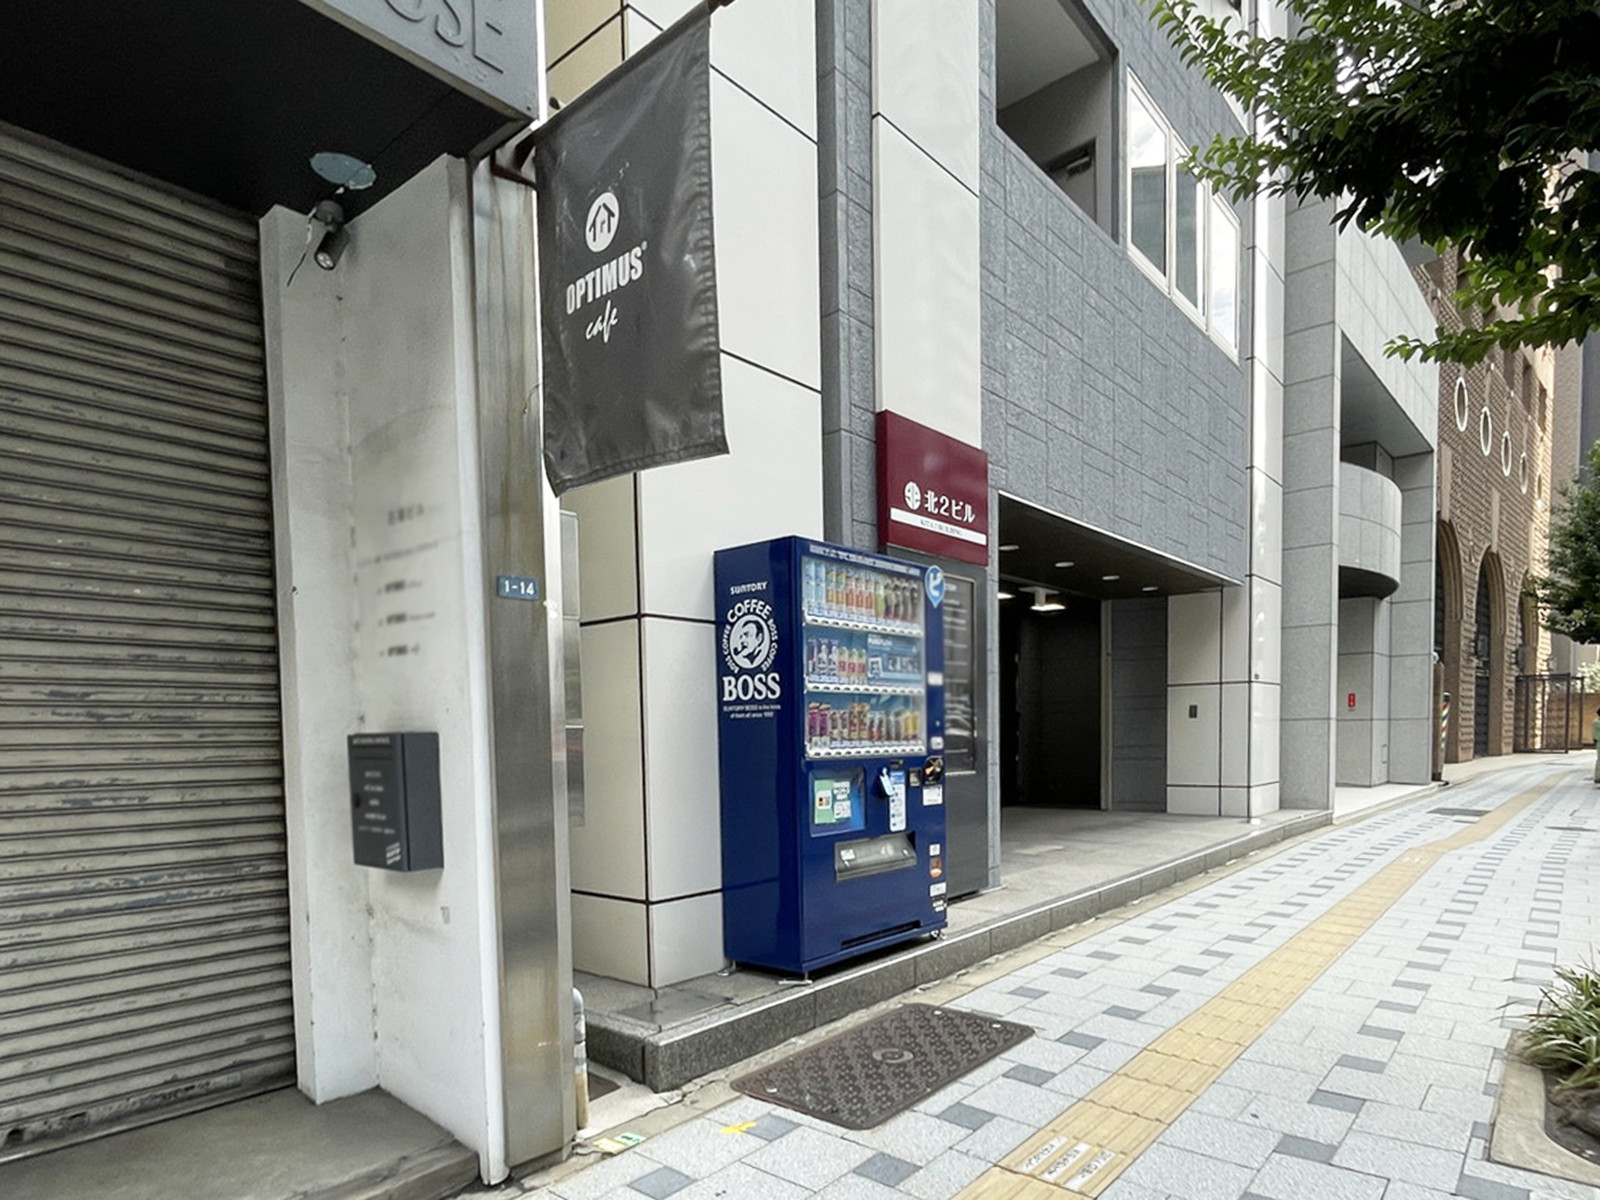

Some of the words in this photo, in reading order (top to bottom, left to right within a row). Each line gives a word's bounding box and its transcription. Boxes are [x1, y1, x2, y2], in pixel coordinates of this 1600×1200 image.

[504, 579, 535, 596] 1-14
[727, 599, 772, 623] COFFEE
[723, 673, 781, 702] BOSS
